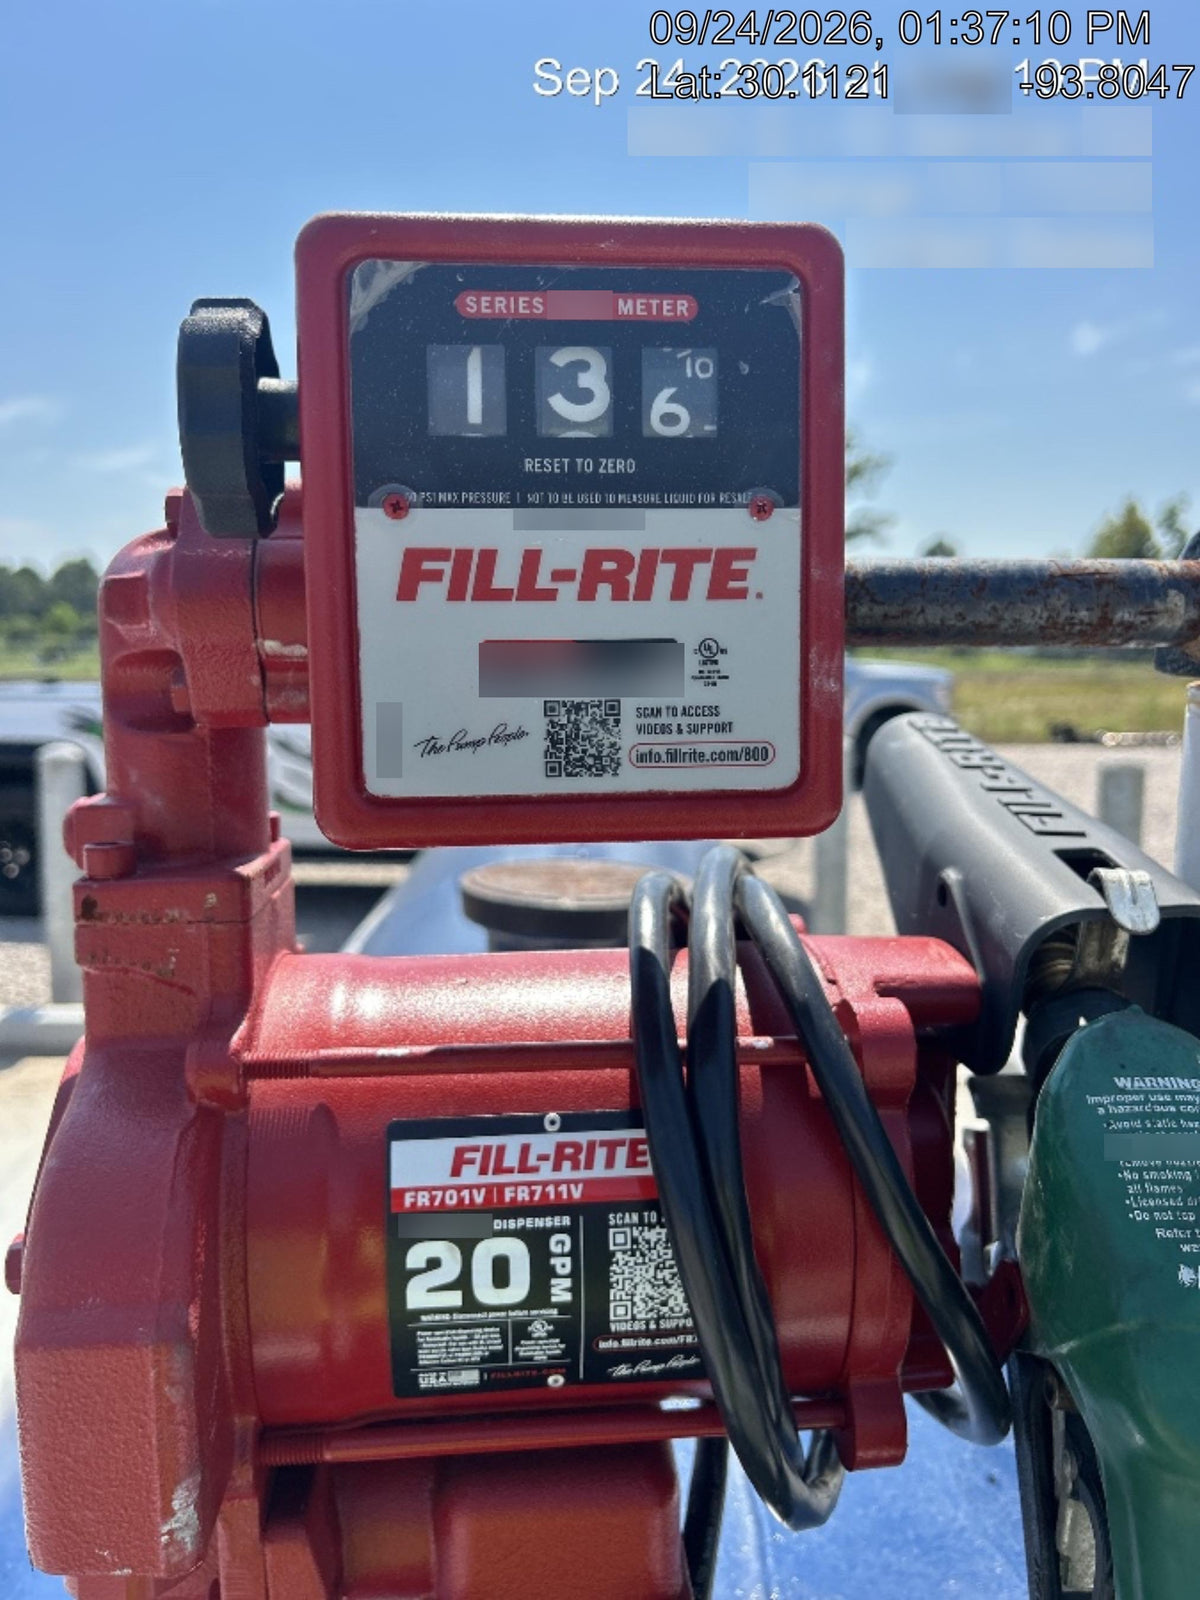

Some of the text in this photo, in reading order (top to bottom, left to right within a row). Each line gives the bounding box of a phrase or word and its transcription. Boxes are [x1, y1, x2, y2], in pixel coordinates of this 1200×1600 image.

[465, 296, 690, 317] SERIES METER
[547, 346, 611, 422] 3
[650, 386, 691, 437] 6
[524, 458, 637, 475] RESET TO ZERO
[461, 492, 511, 505] PRESSURE
[577, 492, 601, 504] USED
[618, 492, 662, 504] MEASURE
[396, 547, 757, 602] FILL-RITE
[635, 705, 720, 718] SCAN TO ACCESS
[636, 721, 734, 735] VIDEOS & SUPPORT
[635, 746, 769, 764] info.fillrite.com/800
[450, 1138, 650, 1178] FILL-RITE
[404, 1183, 584, 1208] FR701V FR711V
[493, 1216, 571, 1230] DISPENSER
[609, 1212, 639, 1226] SCAN
[643, 1210, 657, 1224] TO
[405, 1236, 531, 1310] 20
[549, 1233, 573, 1303] GPM
[660, 1317, 694, 1329] SUPPO
